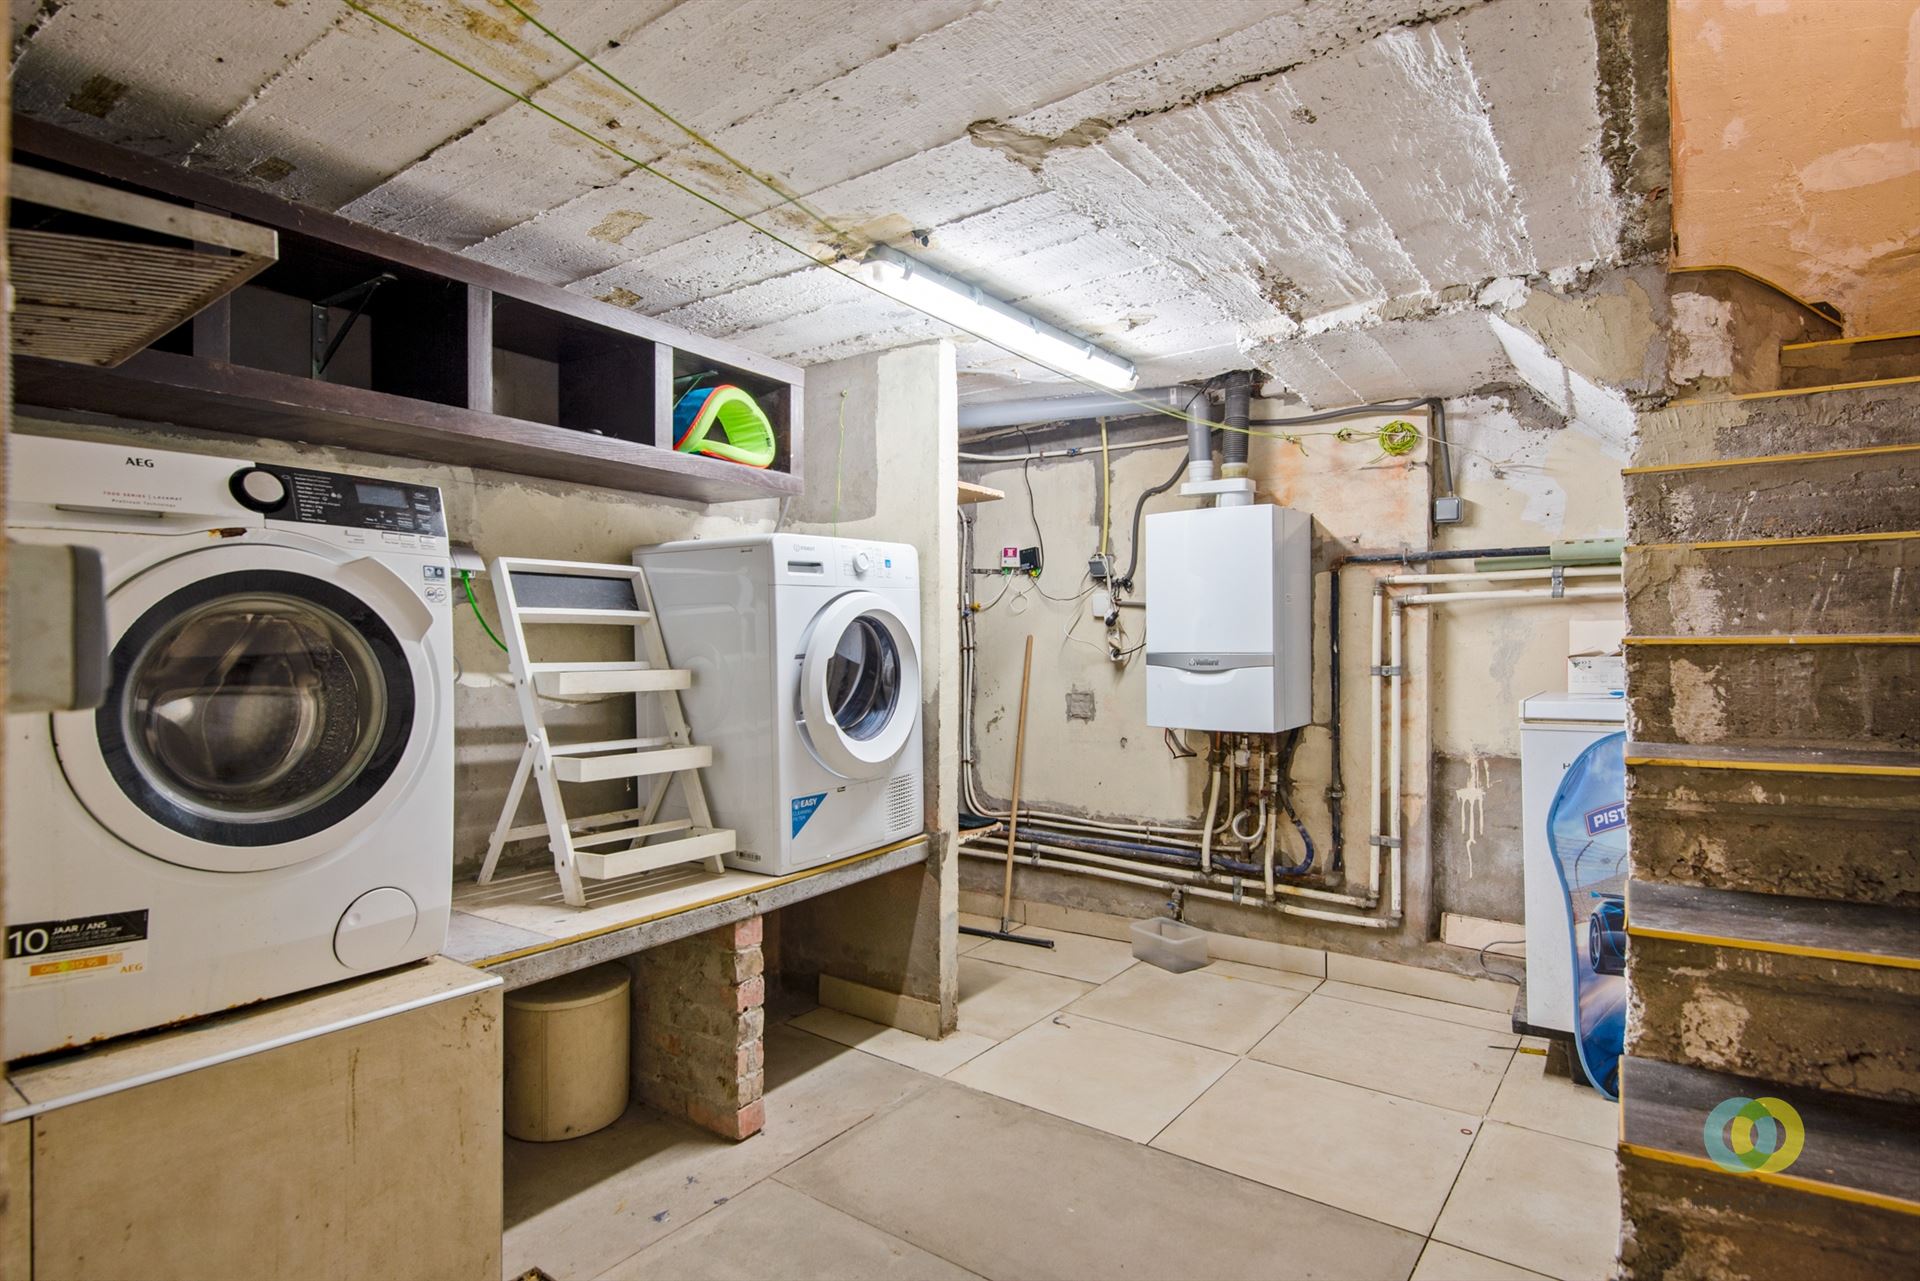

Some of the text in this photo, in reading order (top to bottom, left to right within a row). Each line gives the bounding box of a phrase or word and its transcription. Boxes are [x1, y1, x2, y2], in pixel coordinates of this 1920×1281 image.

[125, 457, 154, 468] AEG
[800, 798, 817, 808] EASY
[1593, 807, 1625, 828] PIST
[52, 924, 79, 935] JAAR
[87, 920, 107, 930] ANS
[8, 929, 49, 955] 10
[120, 964, 143, 974] AEG
